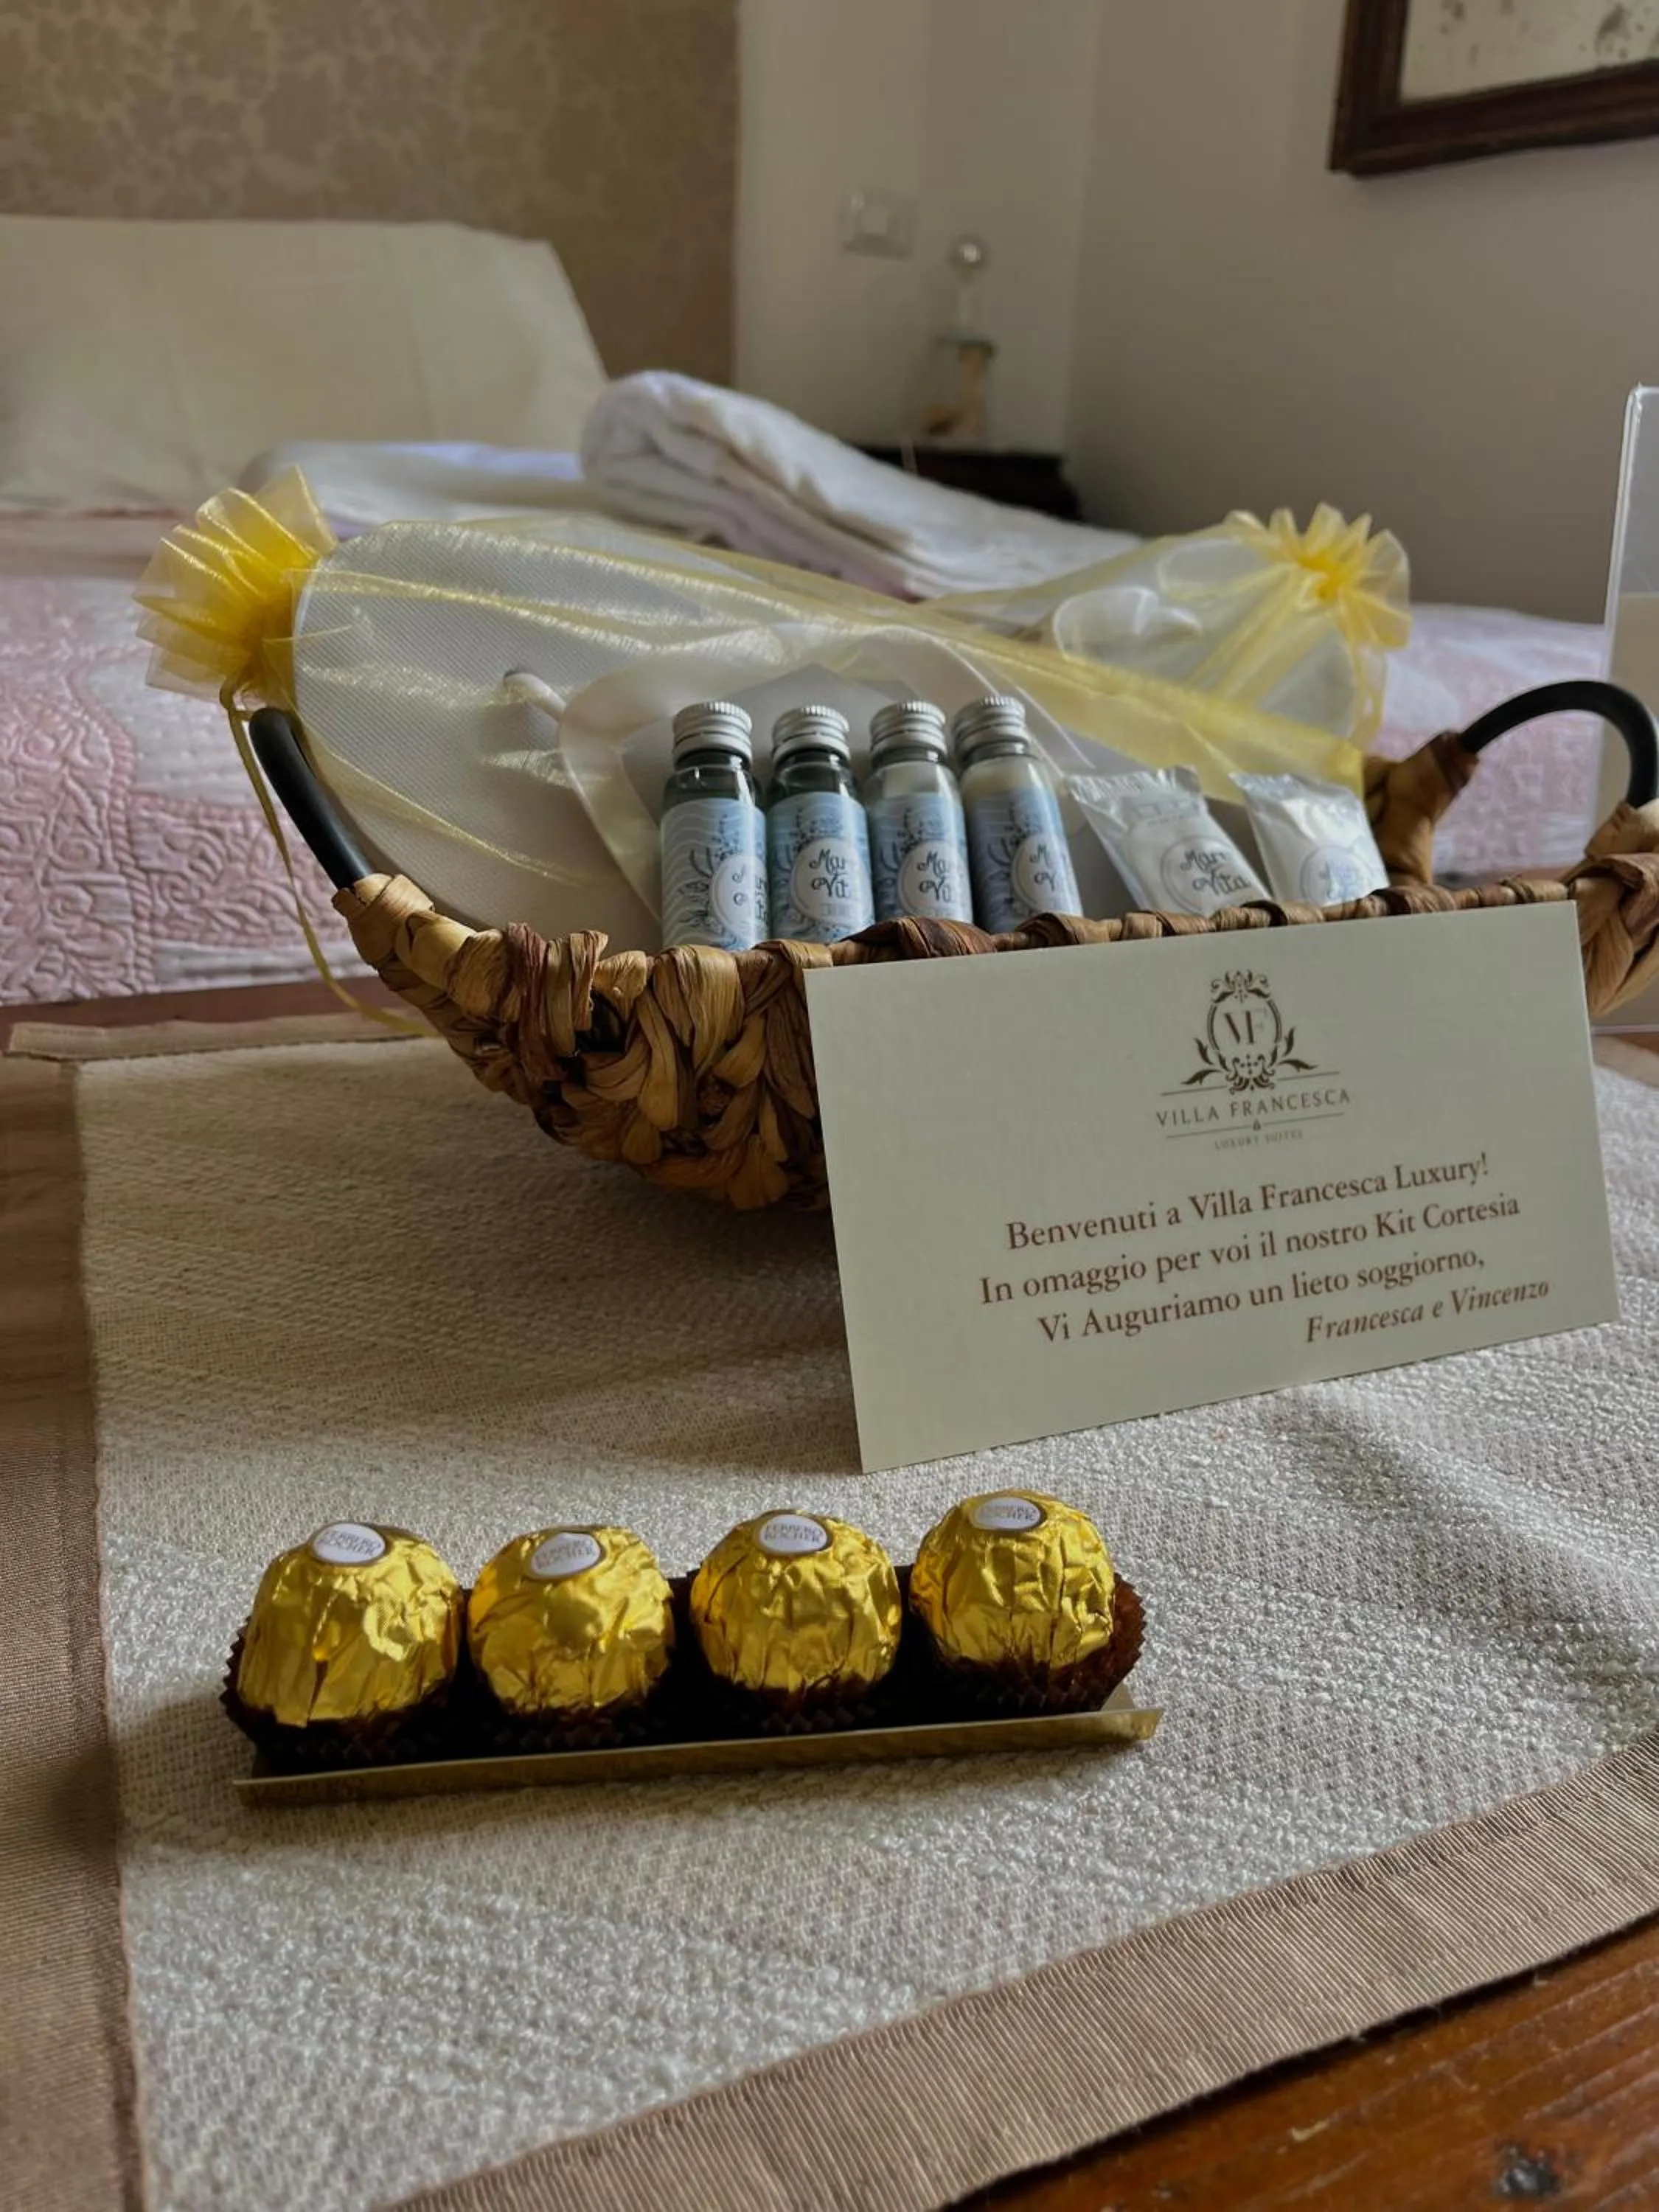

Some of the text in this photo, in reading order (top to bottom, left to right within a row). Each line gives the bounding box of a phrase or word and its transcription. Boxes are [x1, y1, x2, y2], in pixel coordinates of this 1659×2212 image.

[1156, 1088, 1351, 1127] VILLA FRANCESCA
[1006, 1152, 1489, 1250] Benvenuti a Villa Francesca Luxury!
[979, 1192, 1521, 1304] In omaggio per voi il nostro Kit Cortesia
[1037, 1250, 1486, 1342] Vi Auguriamo un lieto soggiorno,
[1306, 1279, 1550, 1343] Francesca e Vincenzo
